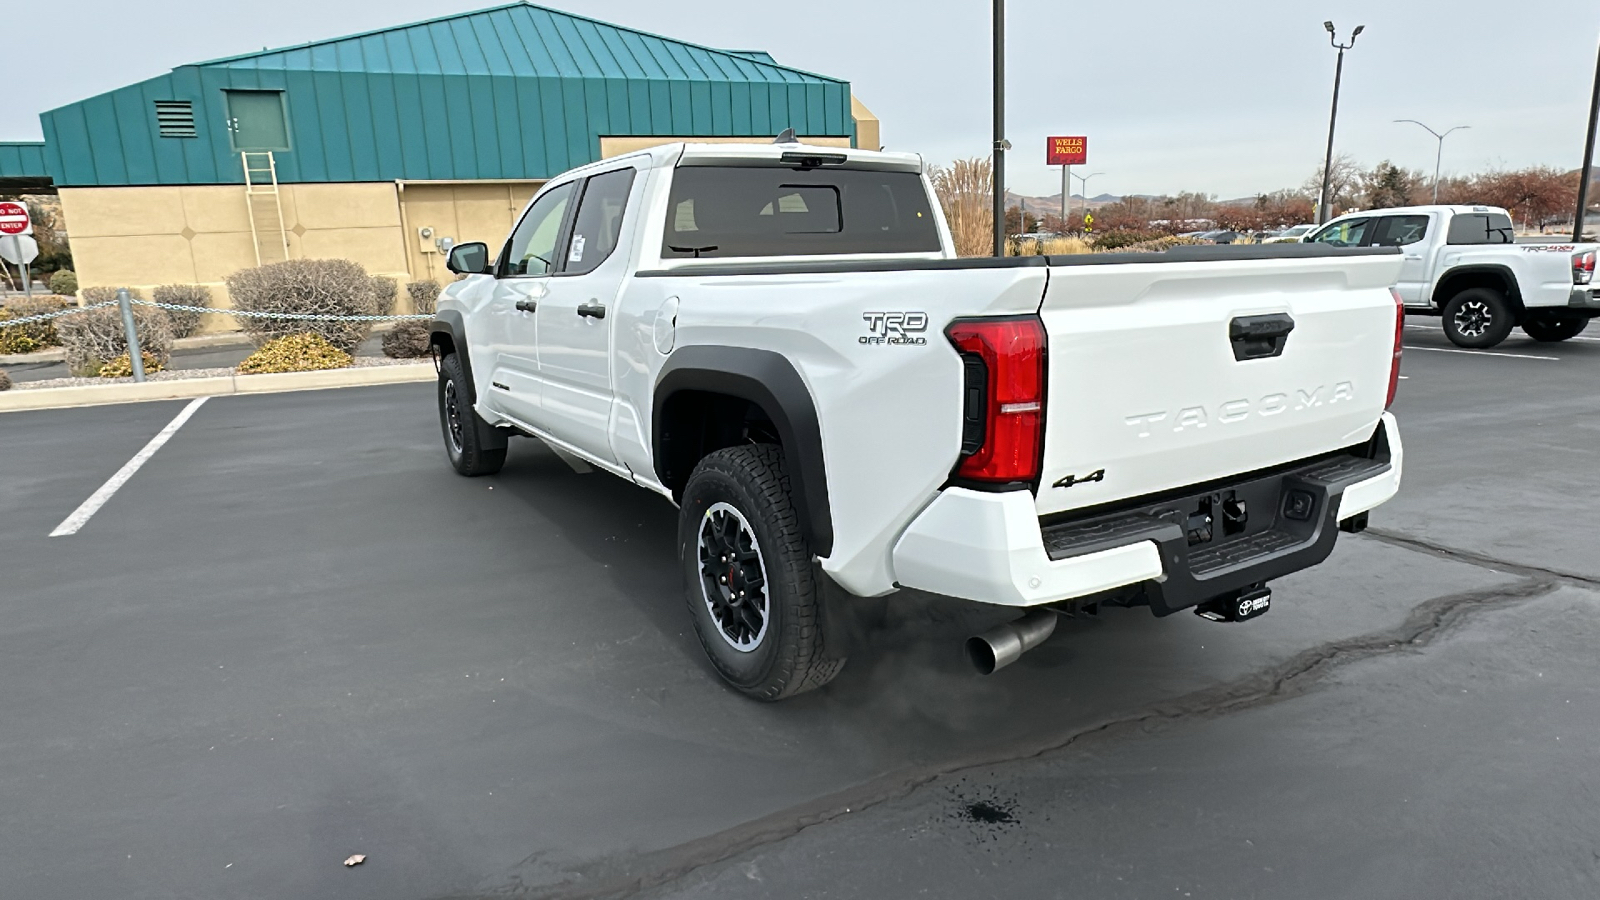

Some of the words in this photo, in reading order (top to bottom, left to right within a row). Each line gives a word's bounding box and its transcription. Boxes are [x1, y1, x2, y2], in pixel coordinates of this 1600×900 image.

[1055, 146, 1082, 154] FARGO
[863, 312, 928, 338] TRD
[858, 336, 886, 345] OFF
[887, 336, 927, 346] ROAD
[1124, 379, 1354, 438] TACOMA
